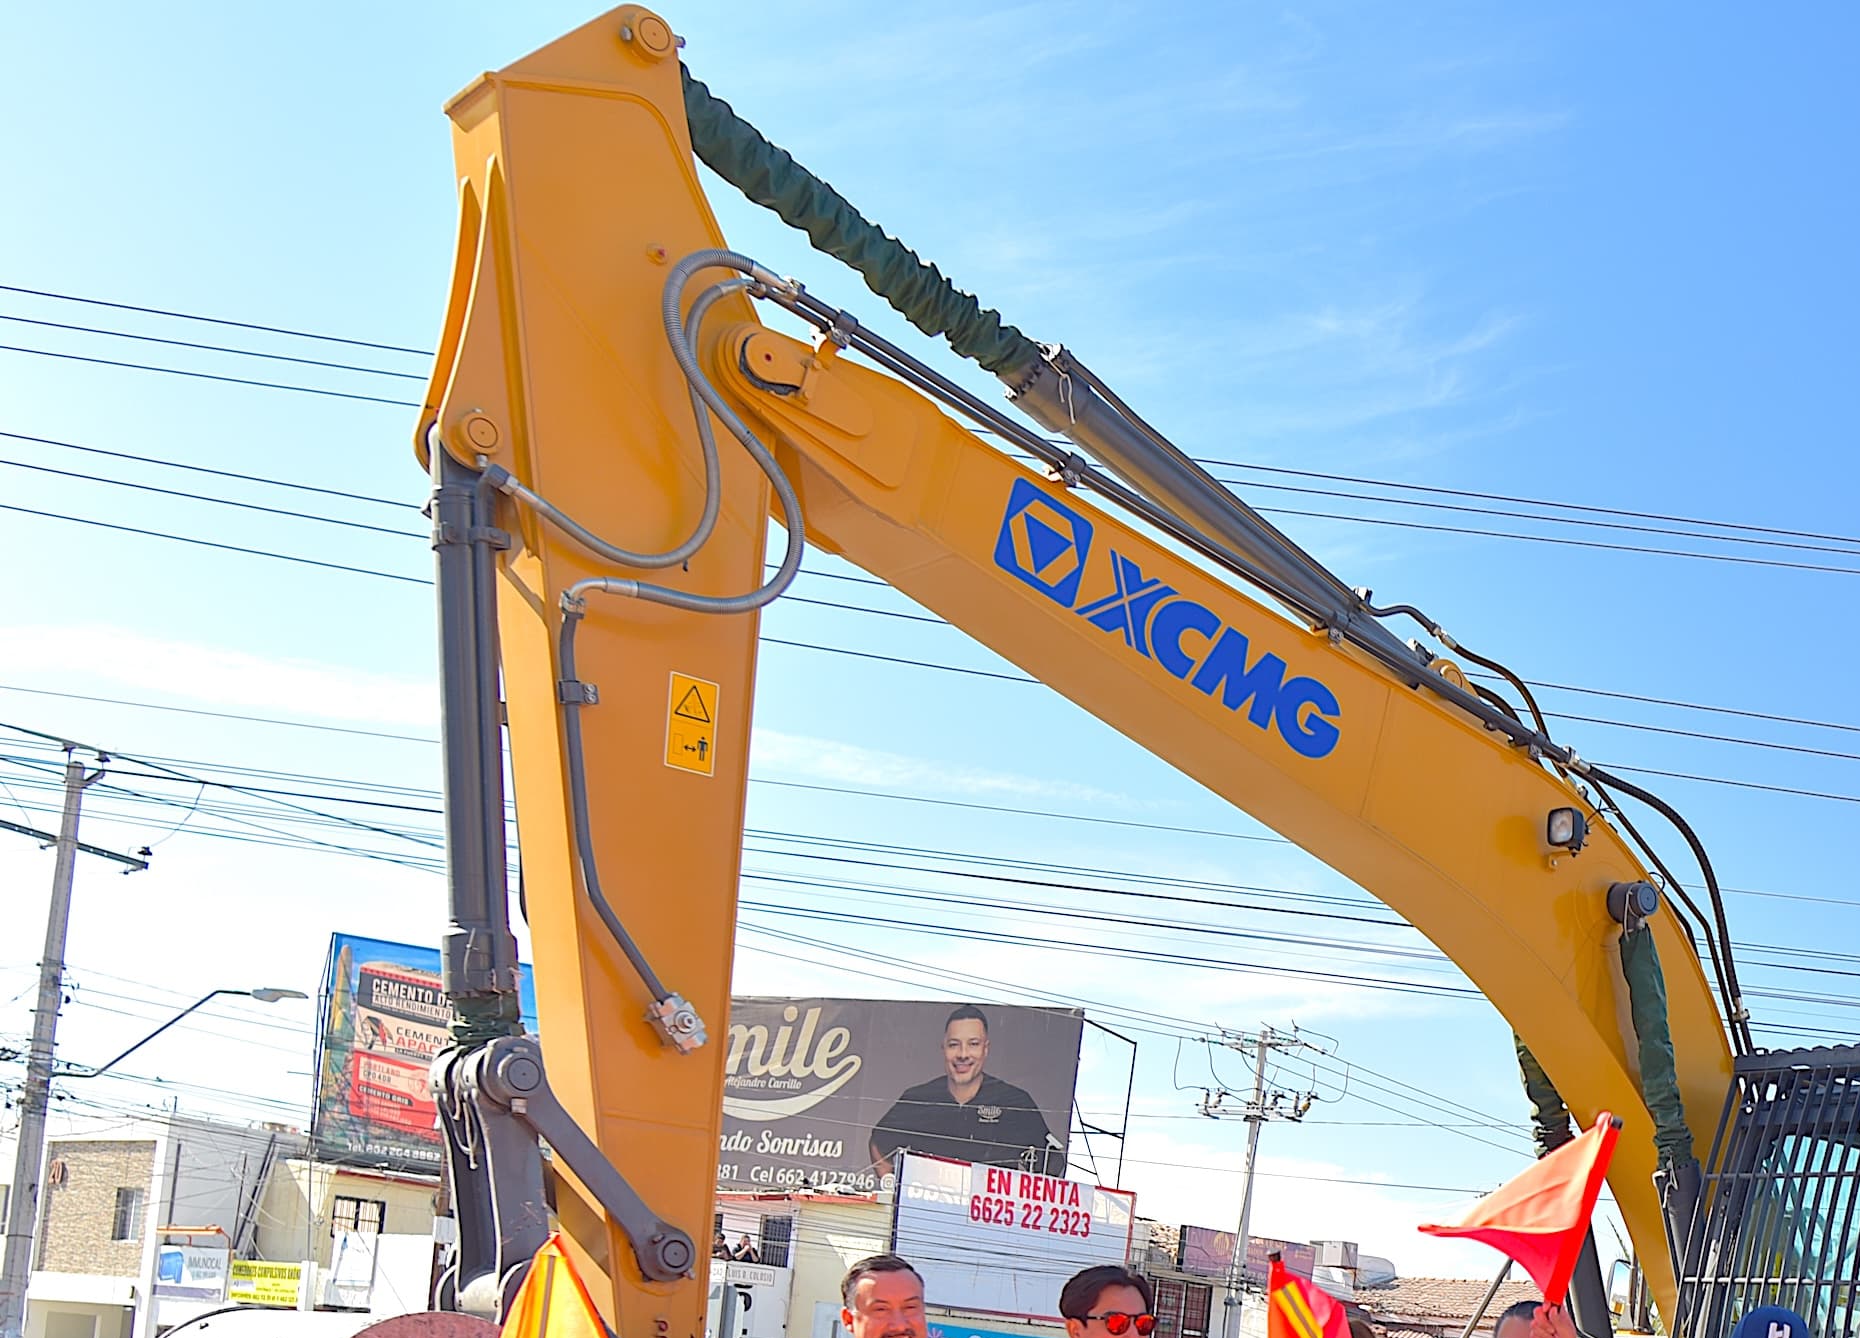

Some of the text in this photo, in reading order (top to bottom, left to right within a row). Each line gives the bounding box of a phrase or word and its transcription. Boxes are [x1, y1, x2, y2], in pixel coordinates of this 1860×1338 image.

[1073, 548, 1341, 759] XCMG
[372, 978, 433, 1004] CEMENTO
[395, 999, 451, 1019] RENDIMIENTO
[396, 1026, 449, 1046] CEMENT
[396, 1036, 436, 1054] APAC
[725, 1005, 861, 1079] mile
[768, 1077, 802, 1090] Carrillo
[719, 1129, 844, 1158] ndo Sonrisas
[750, 1165, 774, 1182] Cel
[776, 1168, 805, 1185] 662
[809, 1171, 875, 1189] 4127946
[986, 1168, 1012, 1195] EN
[1018, 1173, 1080, 1207] RENTA
[970, 1195, 1091, 1238] 6625 22 2323
